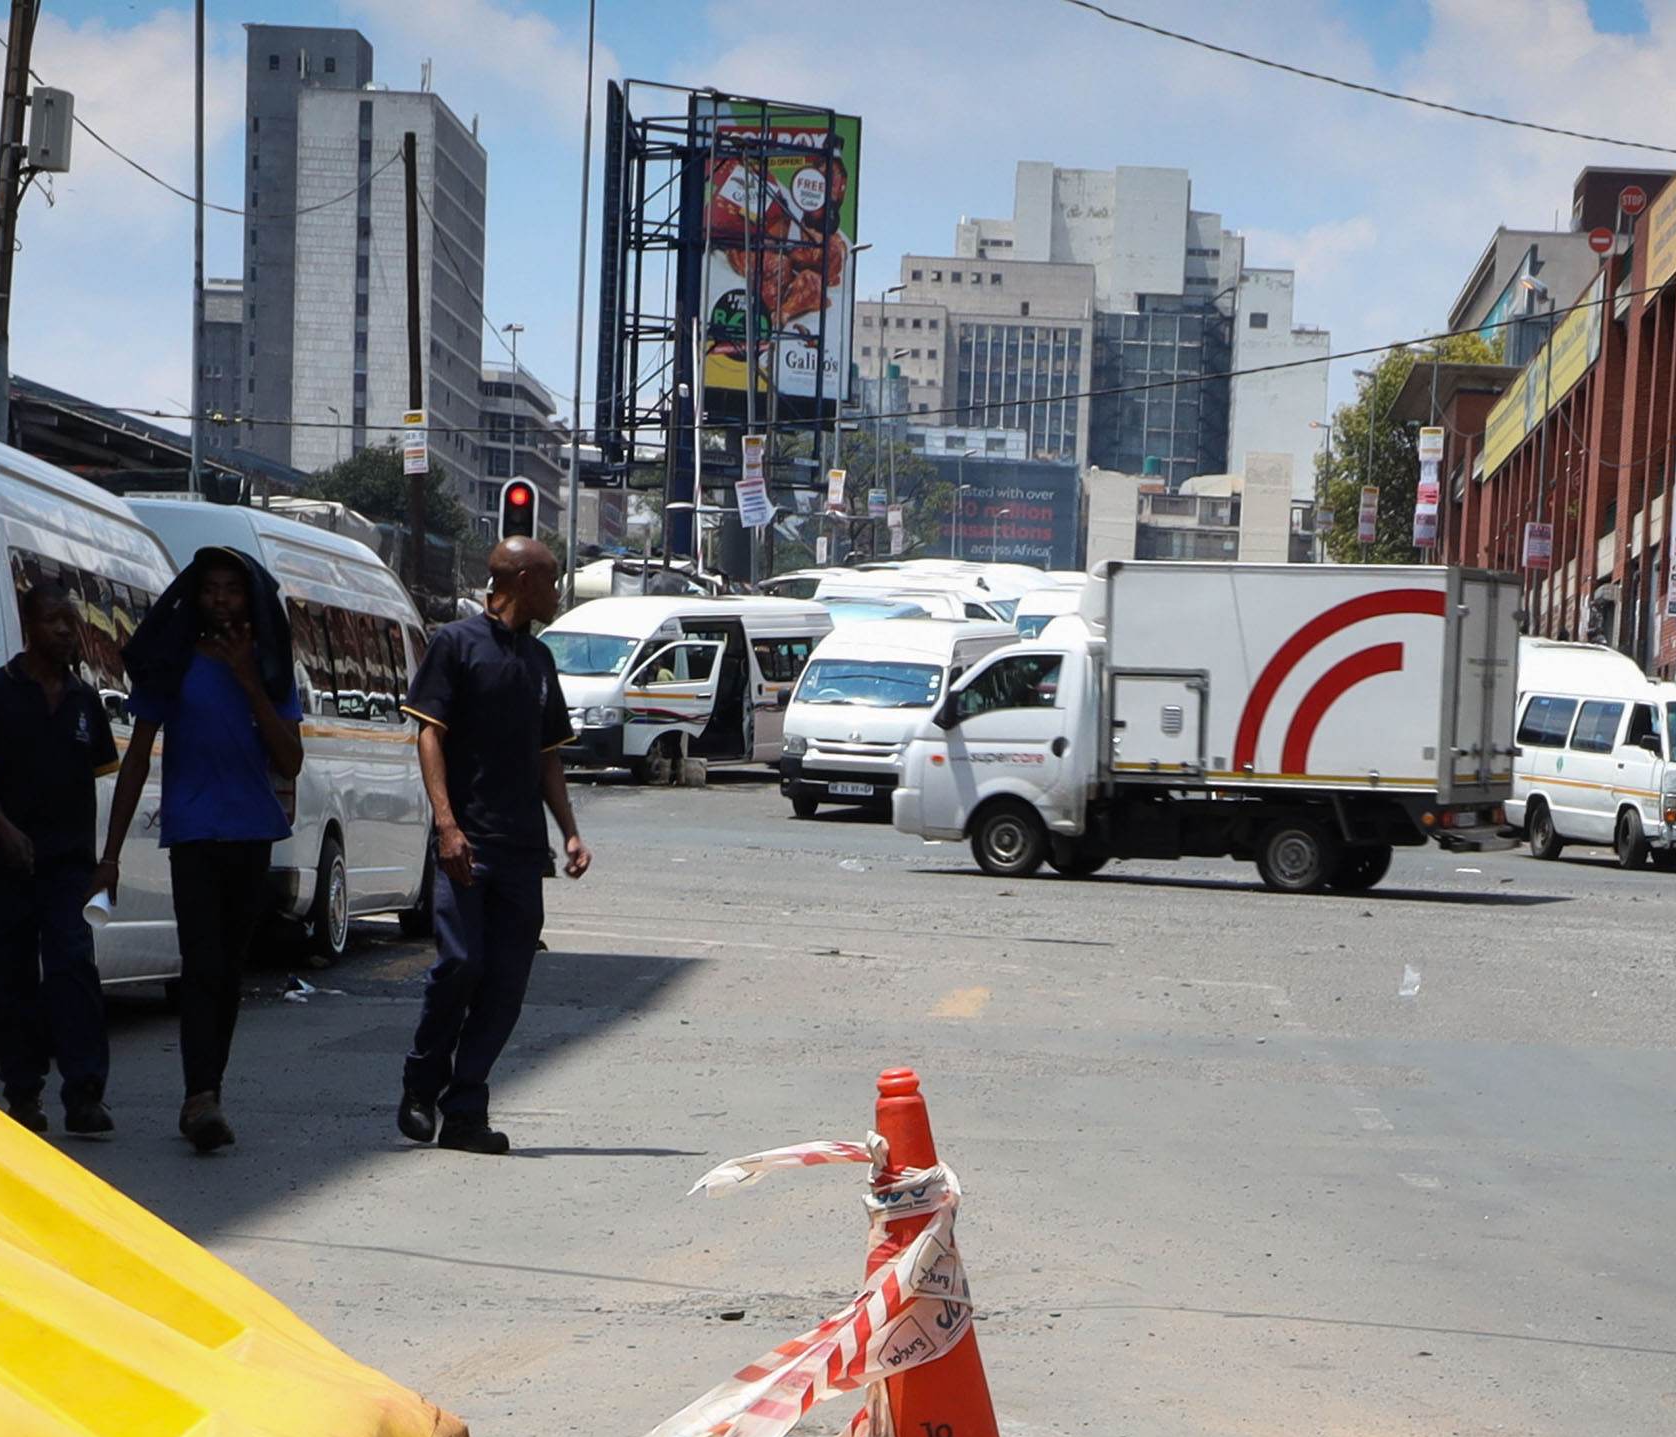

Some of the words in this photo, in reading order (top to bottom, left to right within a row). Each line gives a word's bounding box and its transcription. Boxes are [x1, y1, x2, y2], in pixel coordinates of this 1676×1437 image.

[797, 178, 825, 191] FREE
[1621, 195, 1644, 206] STOP
[785, 349, 838, 373] Galio's
[1026, 489, 1054, 501] over
